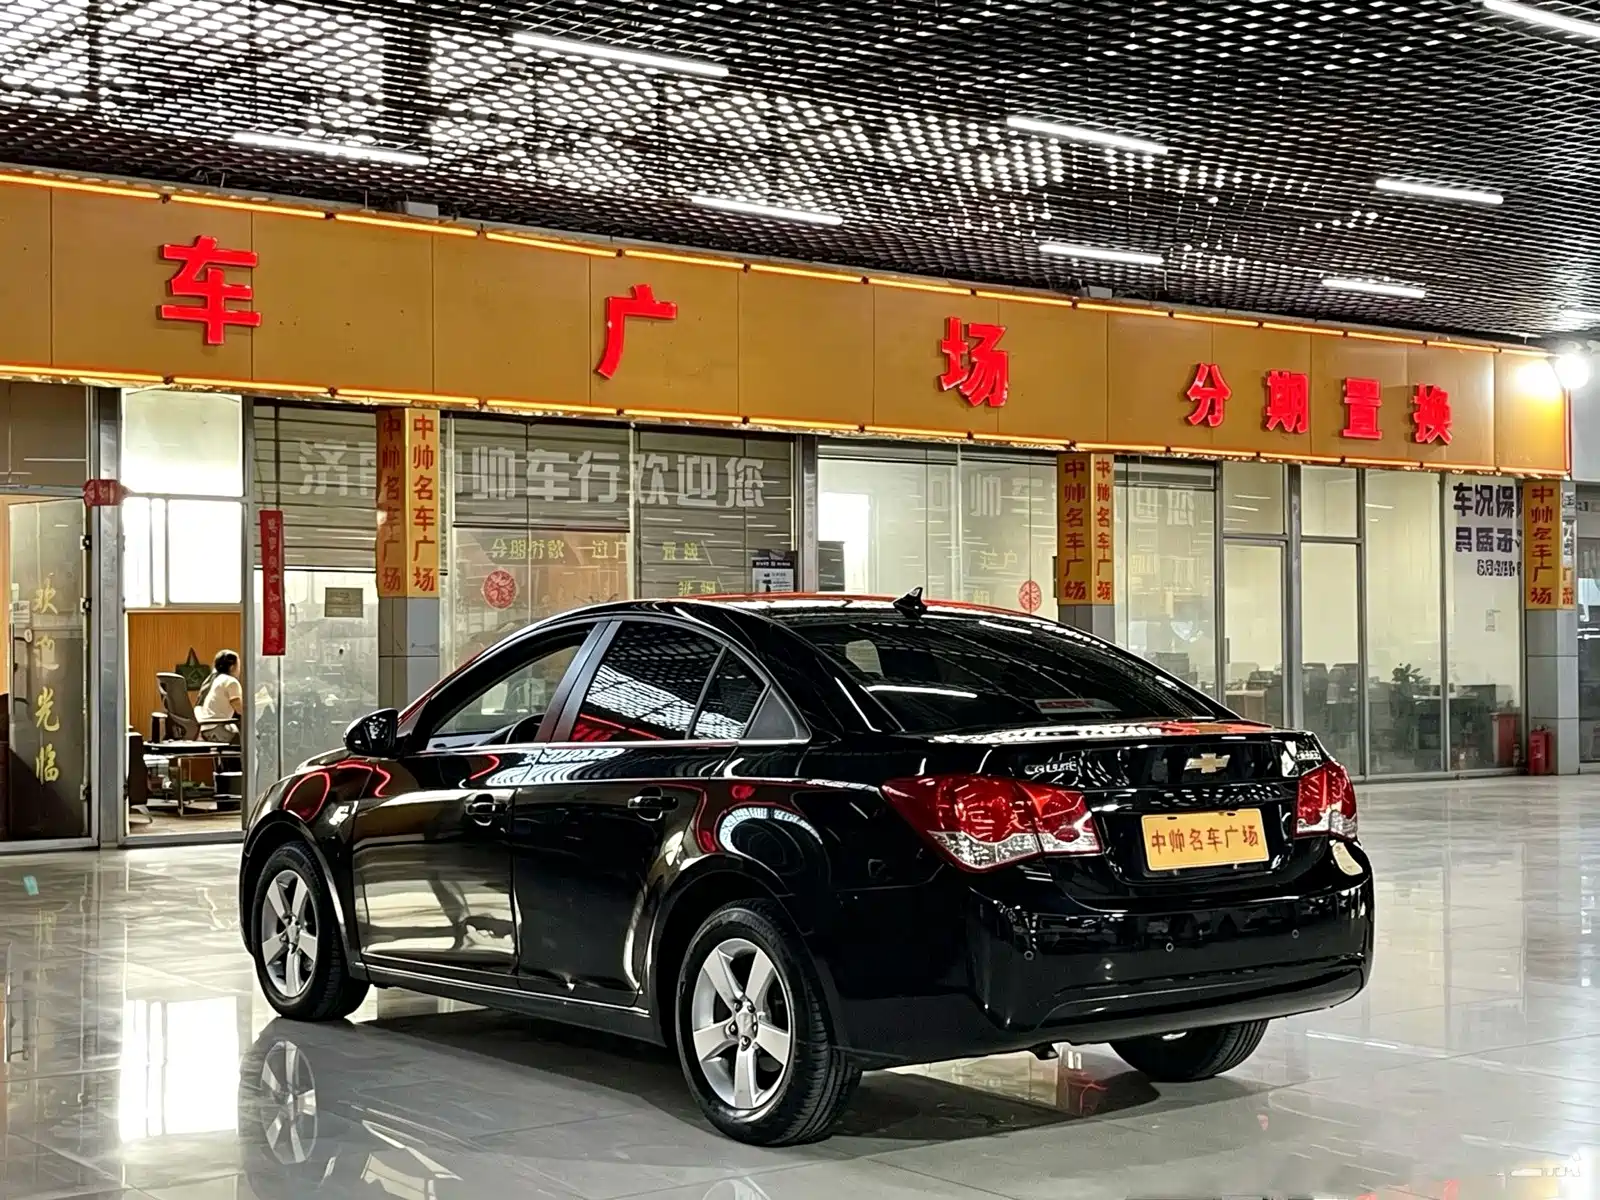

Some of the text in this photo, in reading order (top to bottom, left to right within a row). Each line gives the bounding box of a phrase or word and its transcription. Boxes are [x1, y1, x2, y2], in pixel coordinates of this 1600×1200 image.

[1184, 363, 1455, 446] 分期置换
[413, 413, 435, 592] 中帅名车广场
[1064, 459, 1087, 600] 中帅名车广场
[1453, 482, 1523, 519] 车况保
[1531, 486, 1555, 605] 中帅名车广场
[32, 573, 60, 785] 欢迎光临
[1151, 825, 1259, 855] 中帅名车广场
